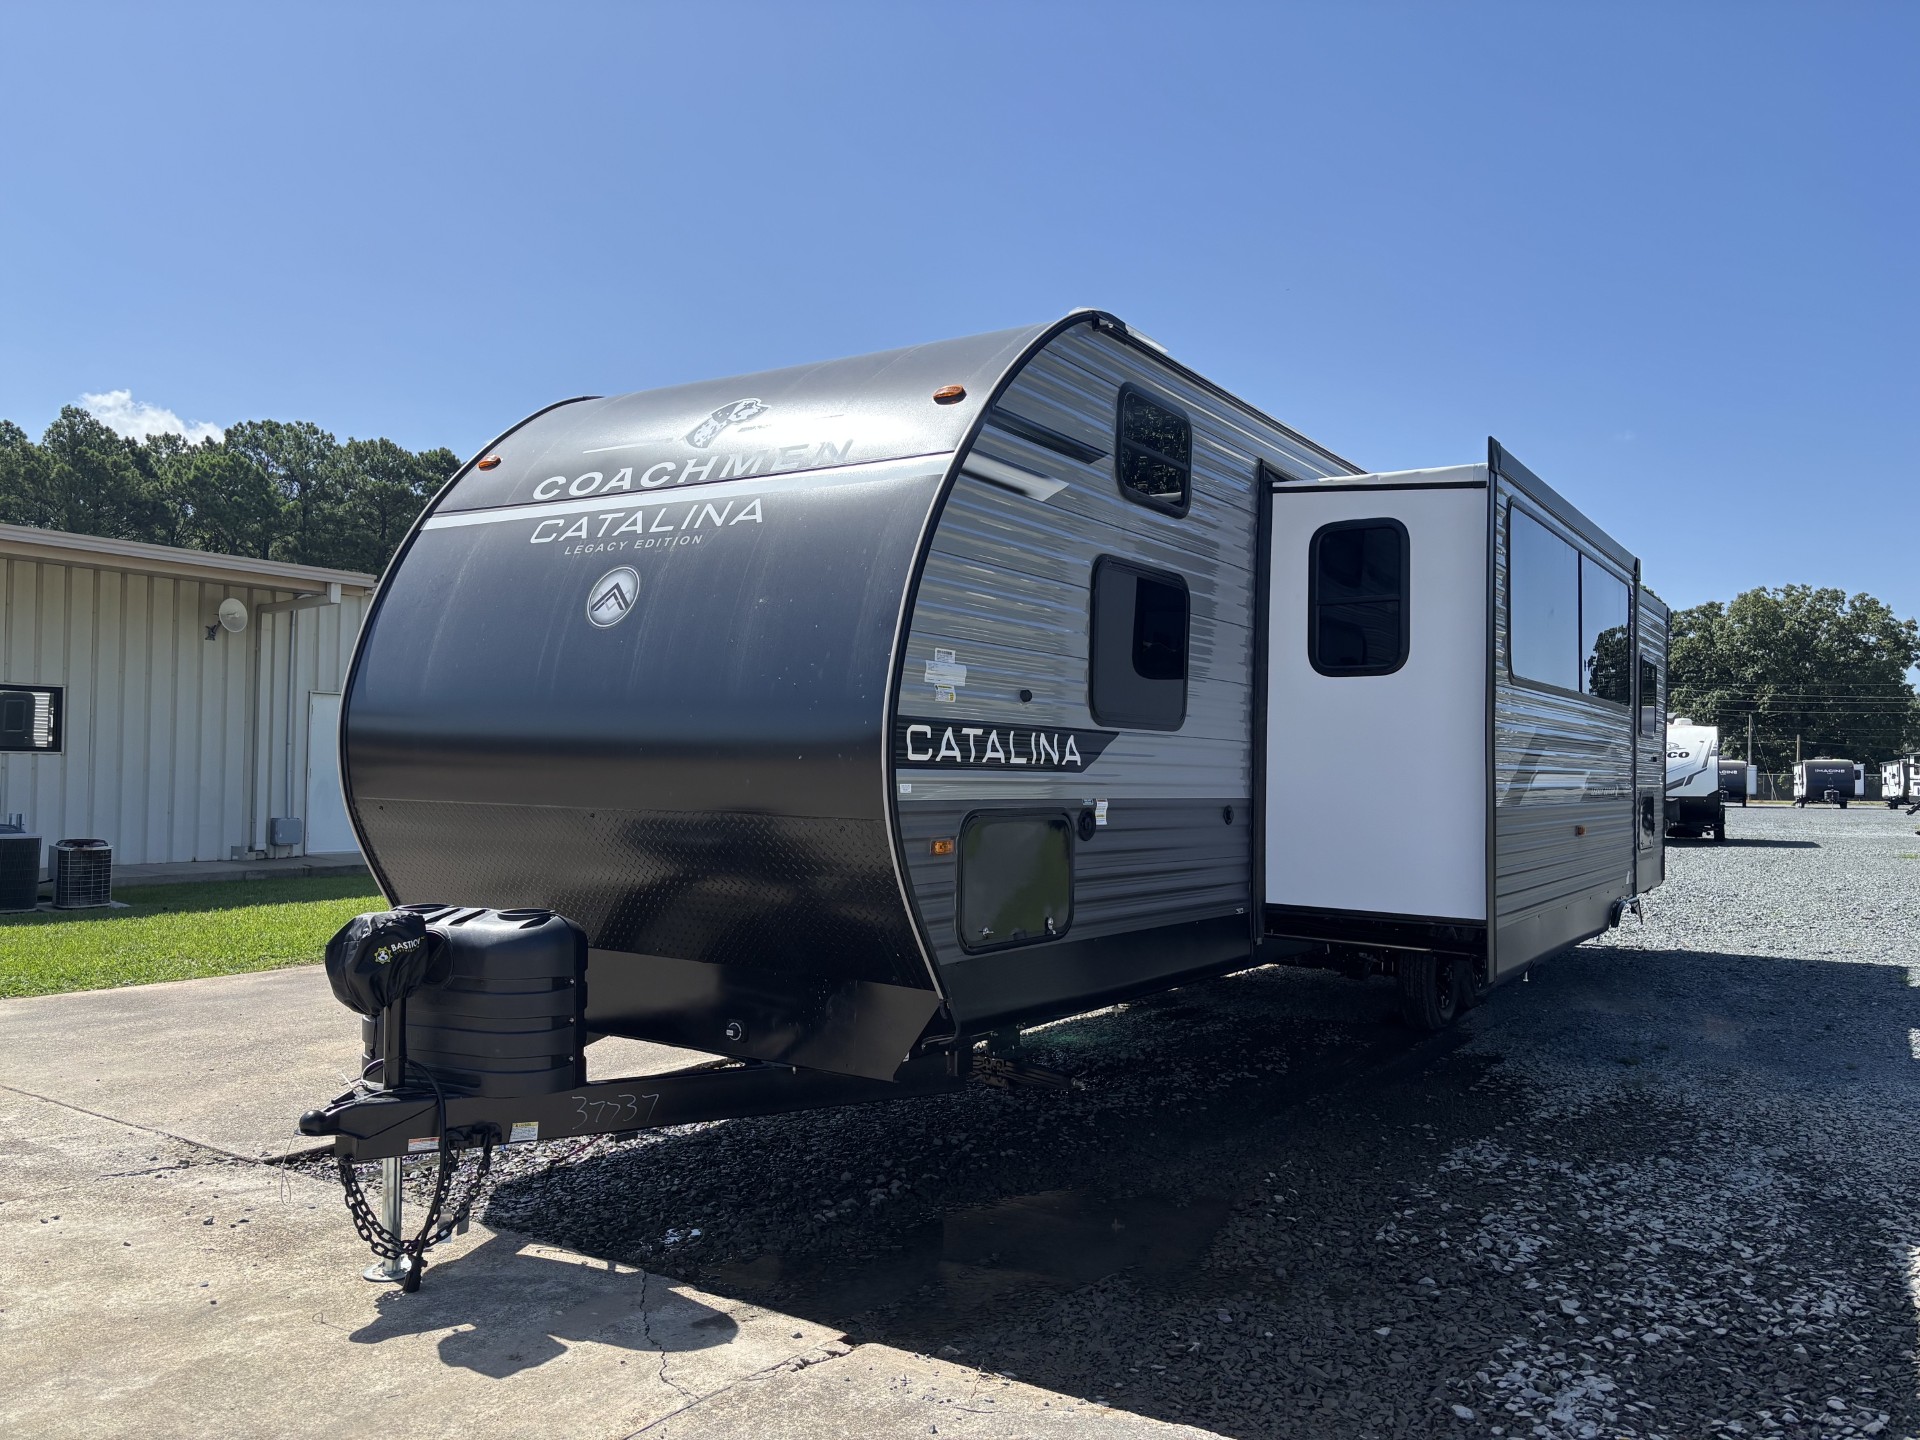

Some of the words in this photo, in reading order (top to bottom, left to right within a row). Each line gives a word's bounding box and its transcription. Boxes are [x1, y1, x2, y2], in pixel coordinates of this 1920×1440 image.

[532, 439, 853, 500] COACHMEN
[530, 499, 763, 544] CATALINA
[564, 537, 628, 555] LEGACY
[634, 535, 703, 549] EDITION
[906, 725, 1082, 766] CATALINA
[572, 1094, 660, 1129] 37737
